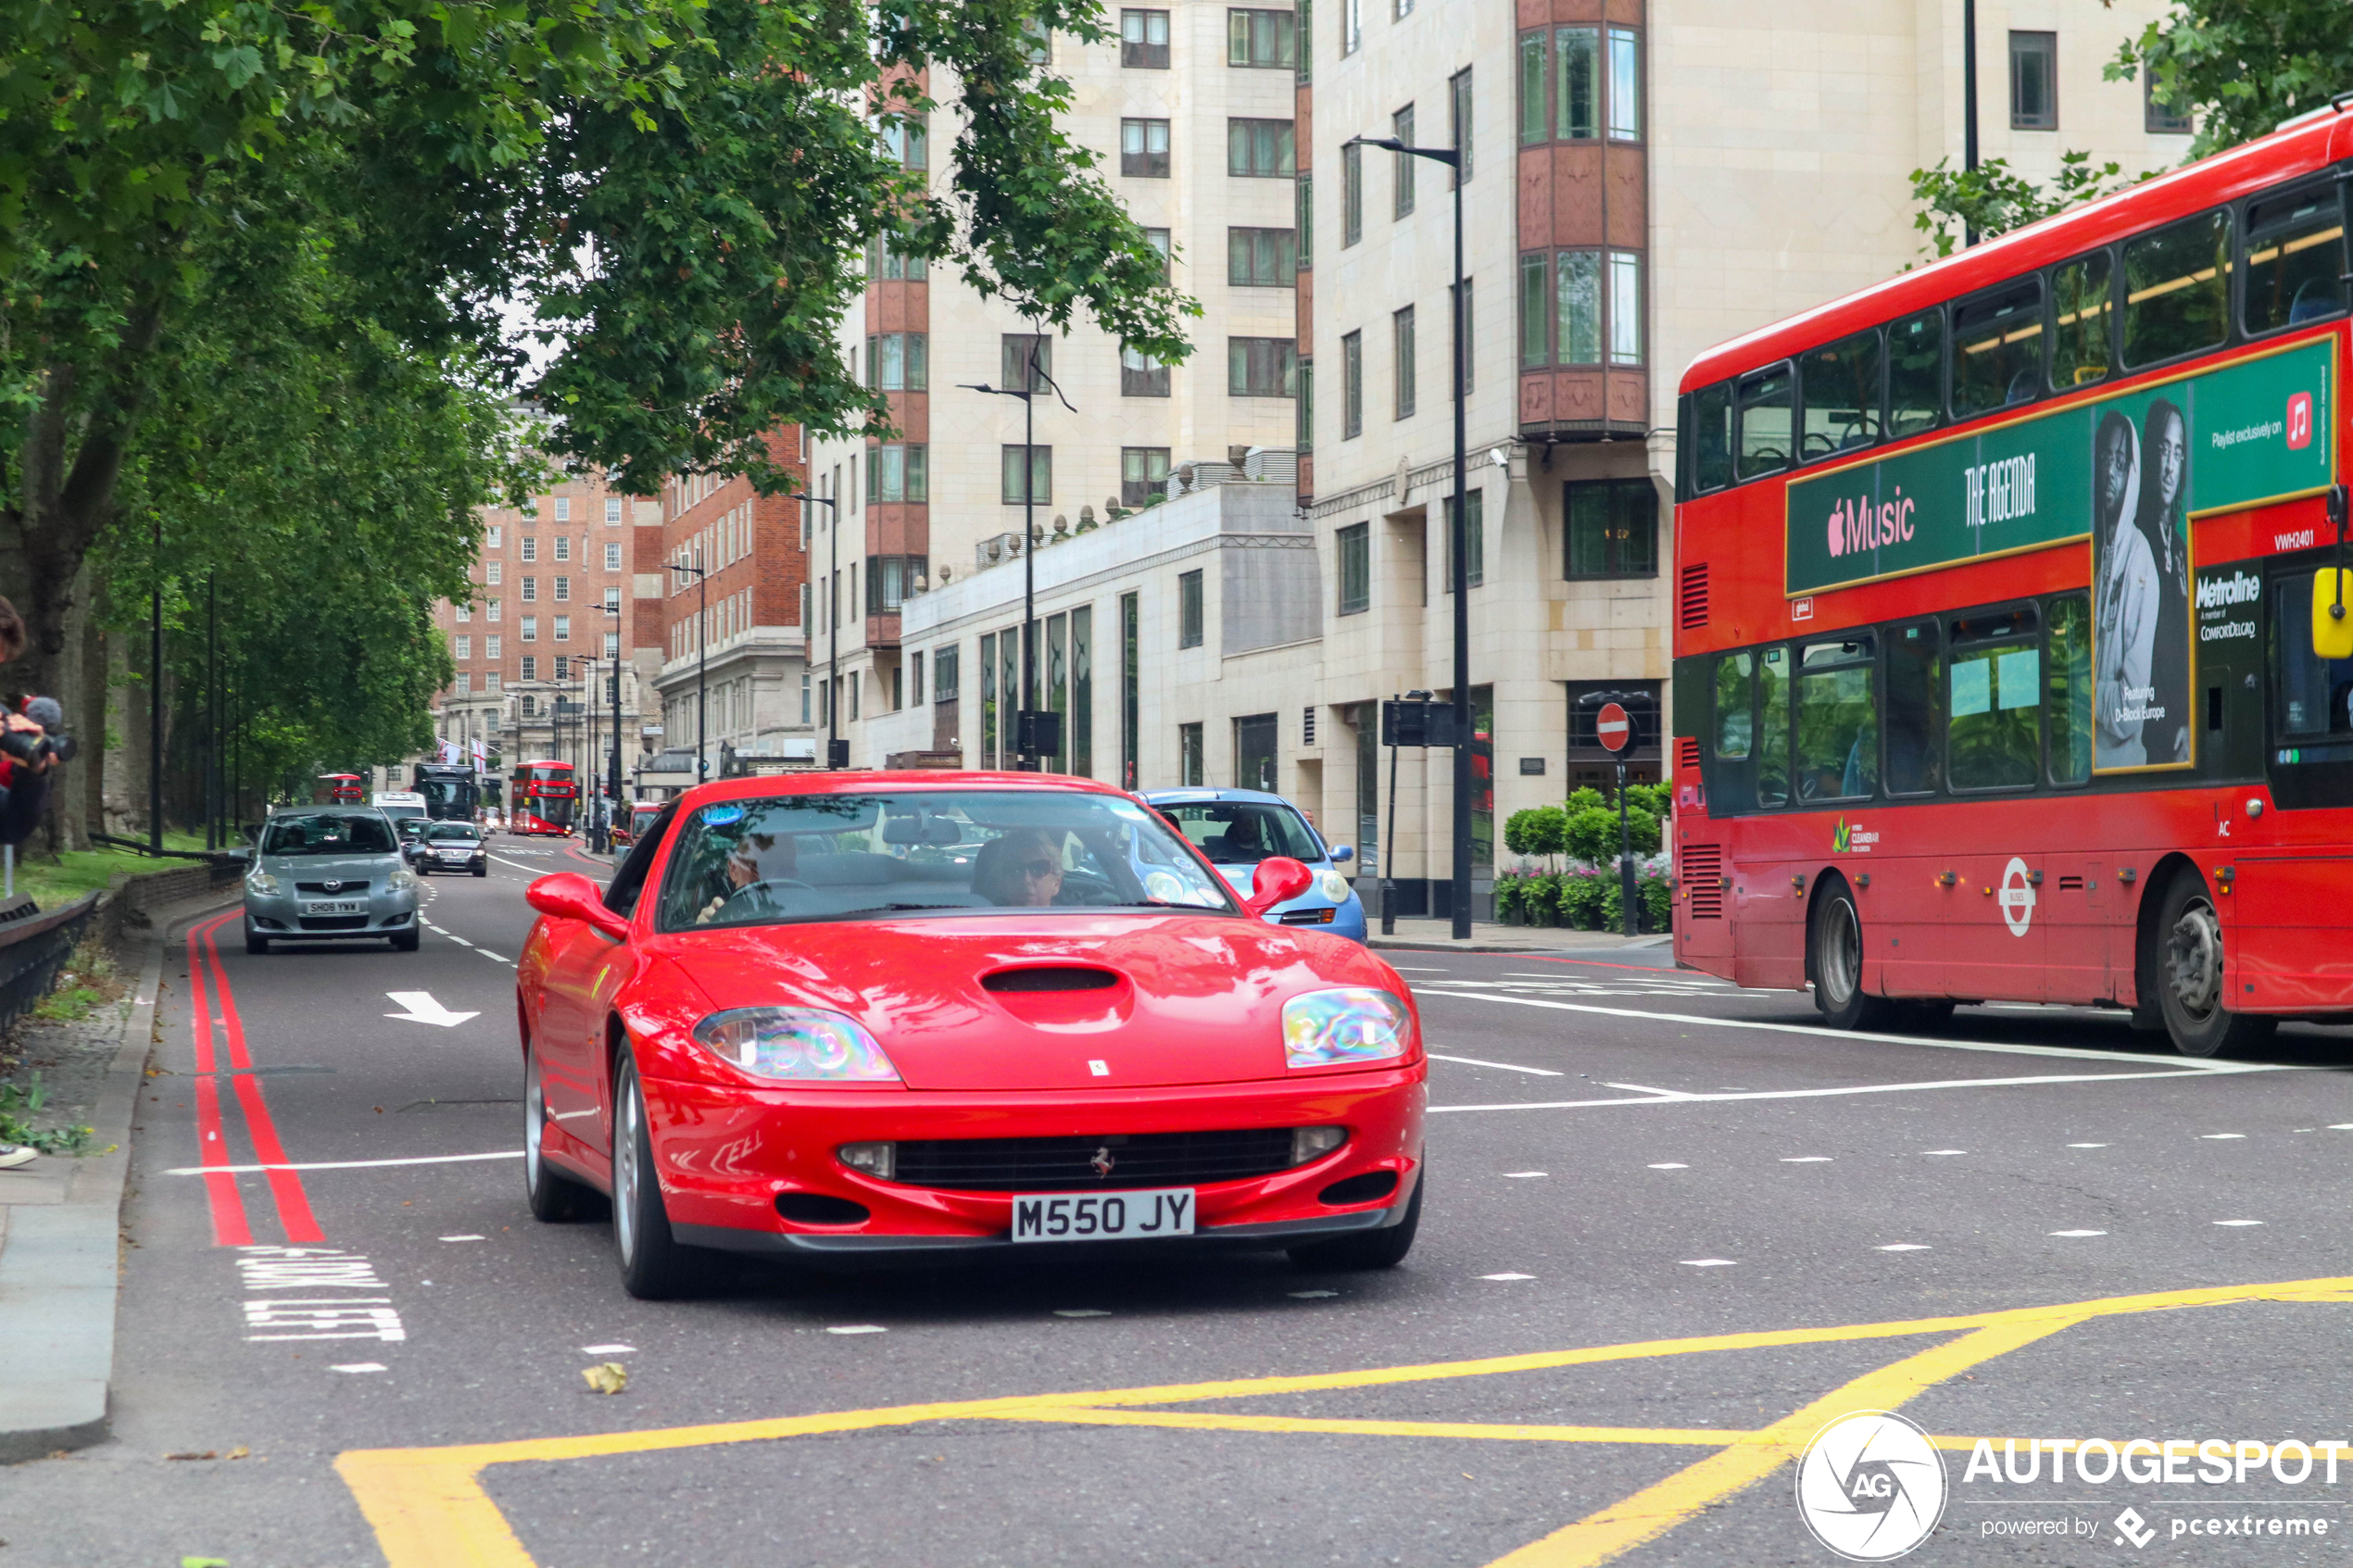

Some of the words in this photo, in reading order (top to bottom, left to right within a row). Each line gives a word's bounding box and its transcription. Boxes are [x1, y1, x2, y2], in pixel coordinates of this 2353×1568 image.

[2212, 429, 2235, 449] Playlist
[2236, 420, 2271, 442] exclusively
[2272, 420, 2282, 434] on
[1964, 465, 1986, 528] THE
[1989, 452, 2036, 523] AGENDA
[1846, 485, 1915, 555] Music
[2274, 529, 2314, 551] VWH2401
[2195, 571, 2260, 608] Metroline
[2124, 684, 2155, 701] Featuring
[2115, 707, 2141, 722] D-Block
[2142, 706, 2165, 721] Europe
[2219, 821, 2230, 836] AC
[2010, 893, 2024, 901] BUSES
[1018, 1198, 1125, 1236] M550
[1139, 1195, 1189, 1232] JY
